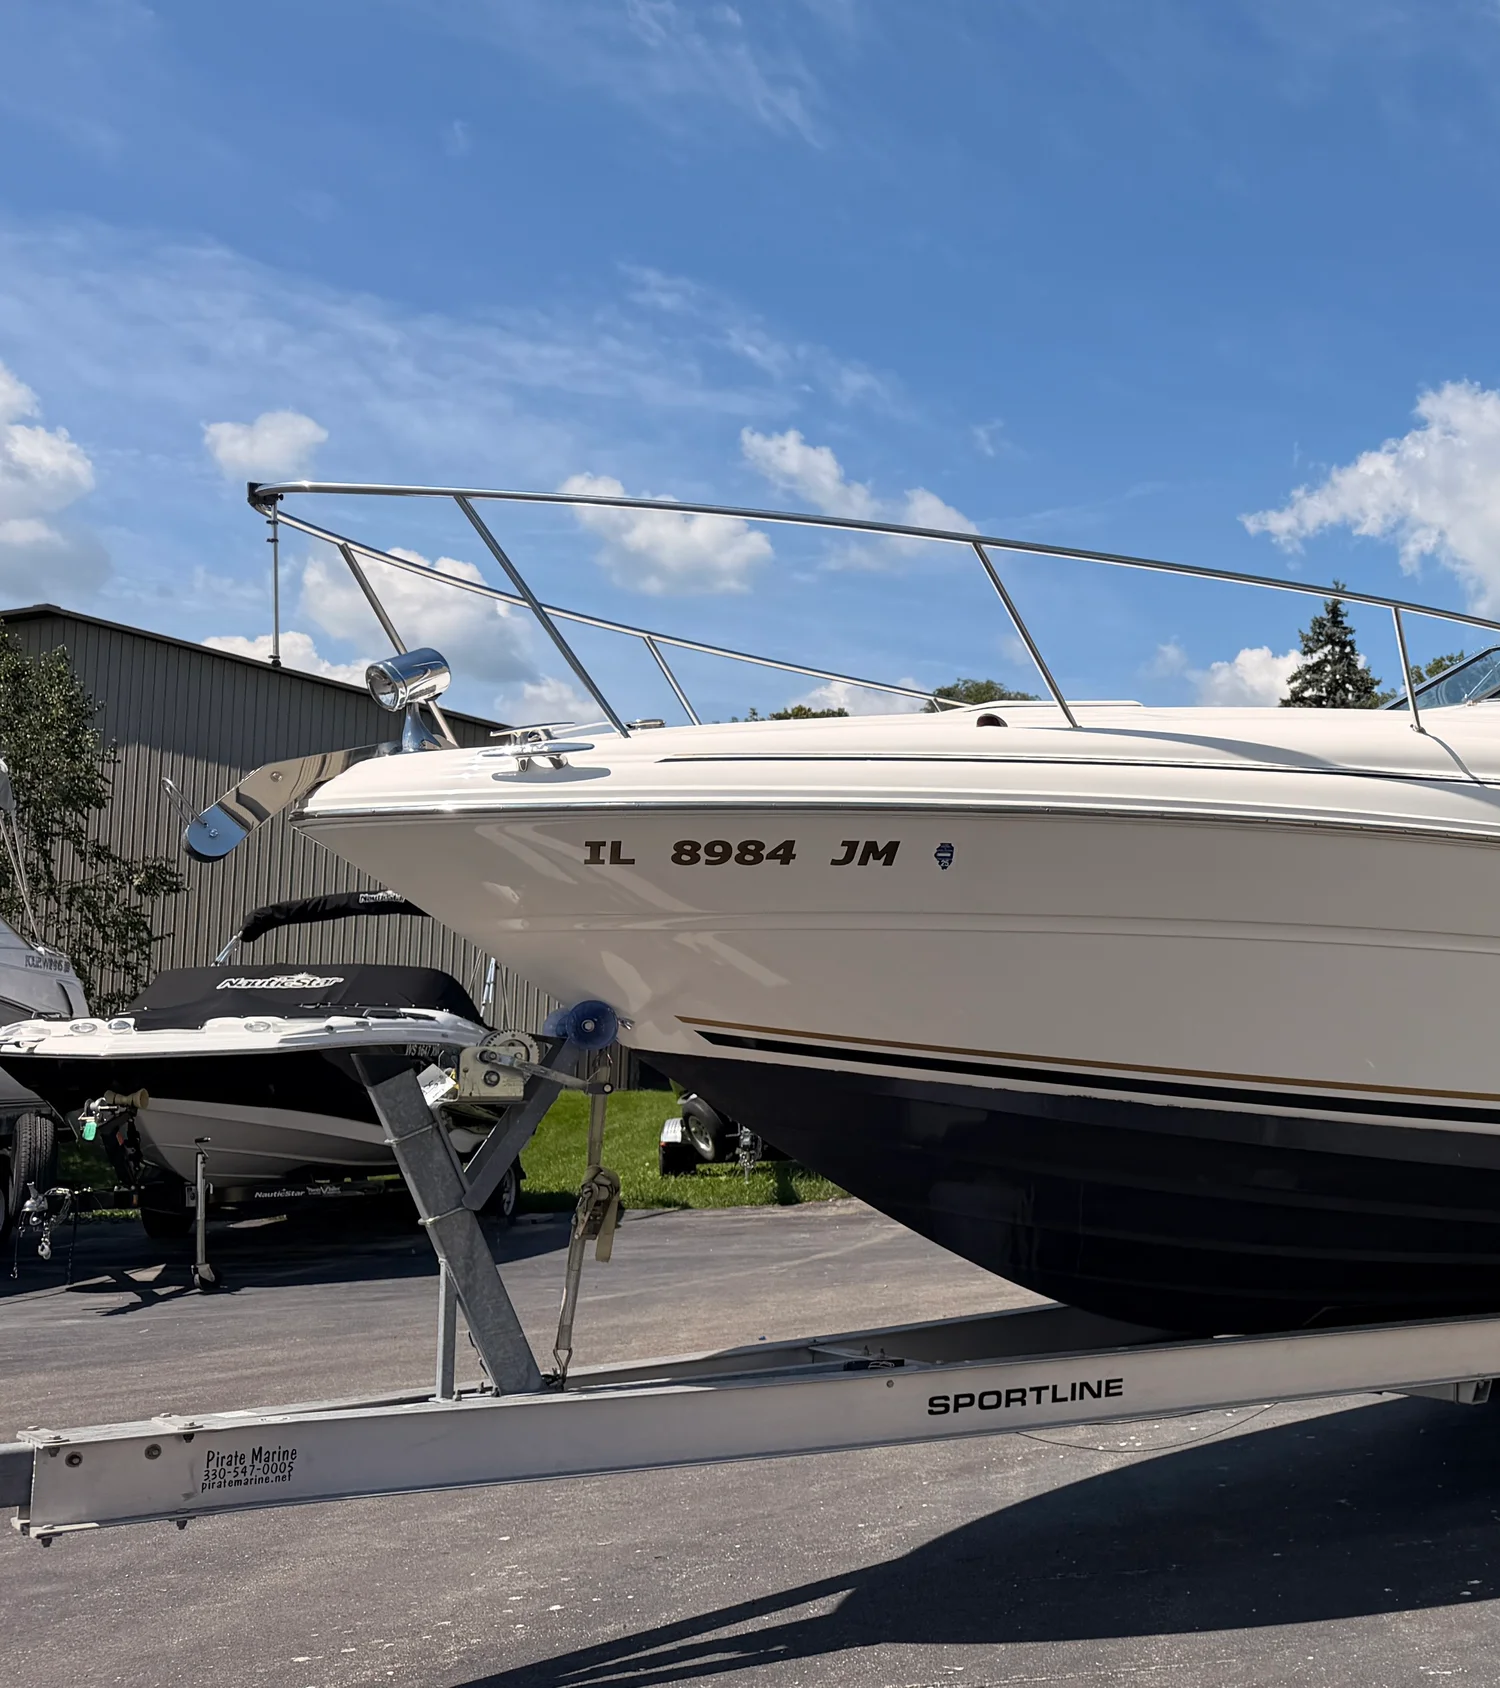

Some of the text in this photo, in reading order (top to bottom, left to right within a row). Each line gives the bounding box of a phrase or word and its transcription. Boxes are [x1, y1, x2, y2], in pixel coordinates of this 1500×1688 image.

[584, 839, 900, 866] IL 8984 JM
[216, 973, 345, 990] NauticStar
[254, 1188, 305, 1199] NauticStar
[927, 1378, 1124, 1416] SPORTLINE
[206, 1446, 297, 1469] Pirate Marine
[201, 1471, 292, 1493] piratemarine.net
[203, 1461, 294, 1481] 330-547-0005
